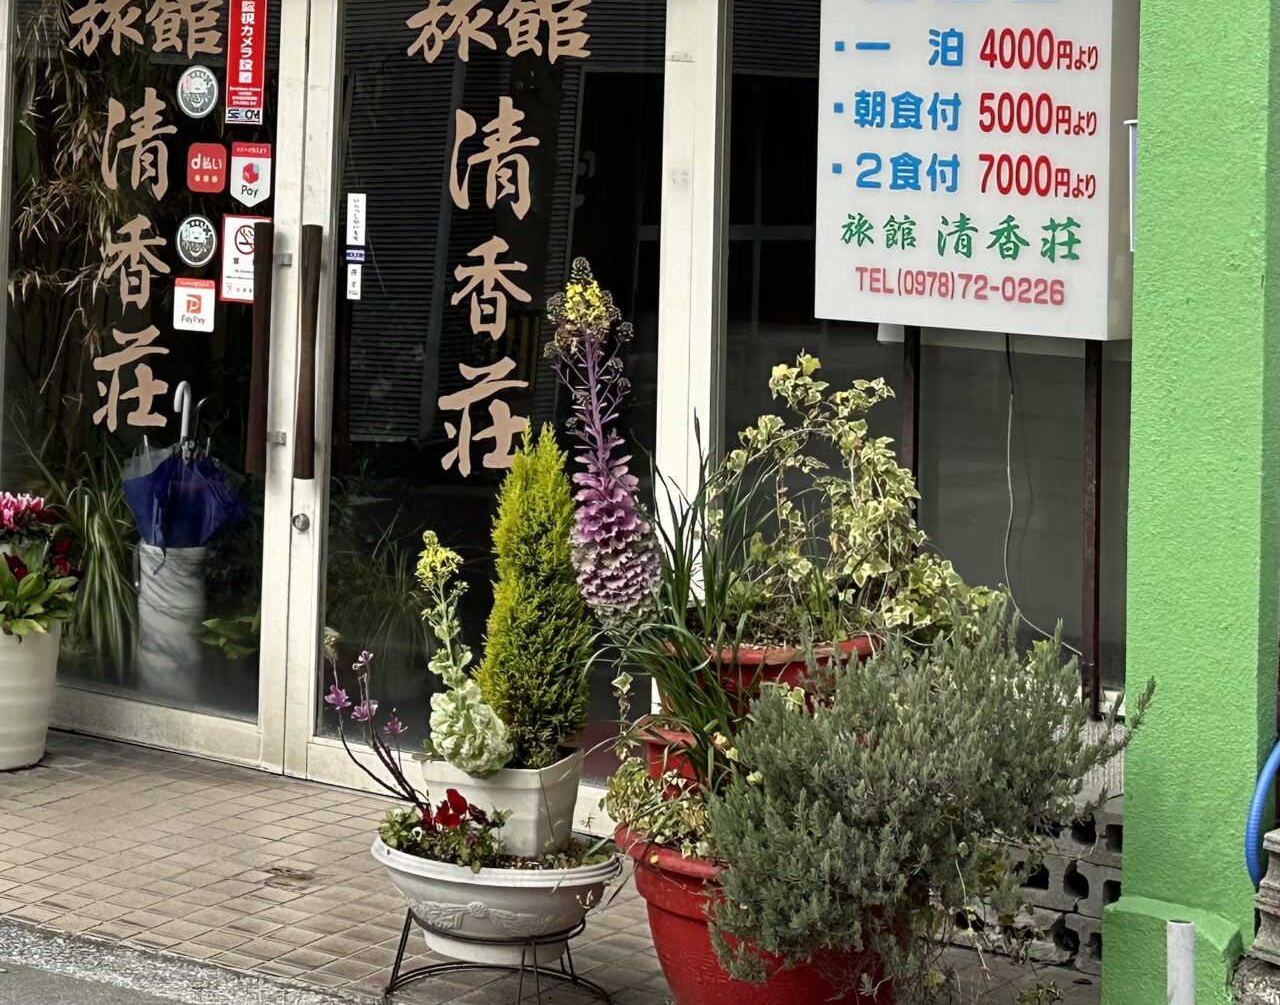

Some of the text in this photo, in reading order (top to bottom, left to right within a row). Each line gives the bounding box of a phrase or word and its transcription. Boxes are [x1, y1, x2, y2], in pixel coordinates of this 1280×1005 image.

[979, 27, 1099, 71] 4000円より
[853, 90, 1097, 136] 朝食付 5000円より
[241, 184, 259, 198] Pay
[978, 153, 1097, 199] 7000円より
[93, 87, 178, 433] 清香荘
[840, 212, 1082, 264] 旅館 清香荘
[438, 96, 541, 478] 清香荘
